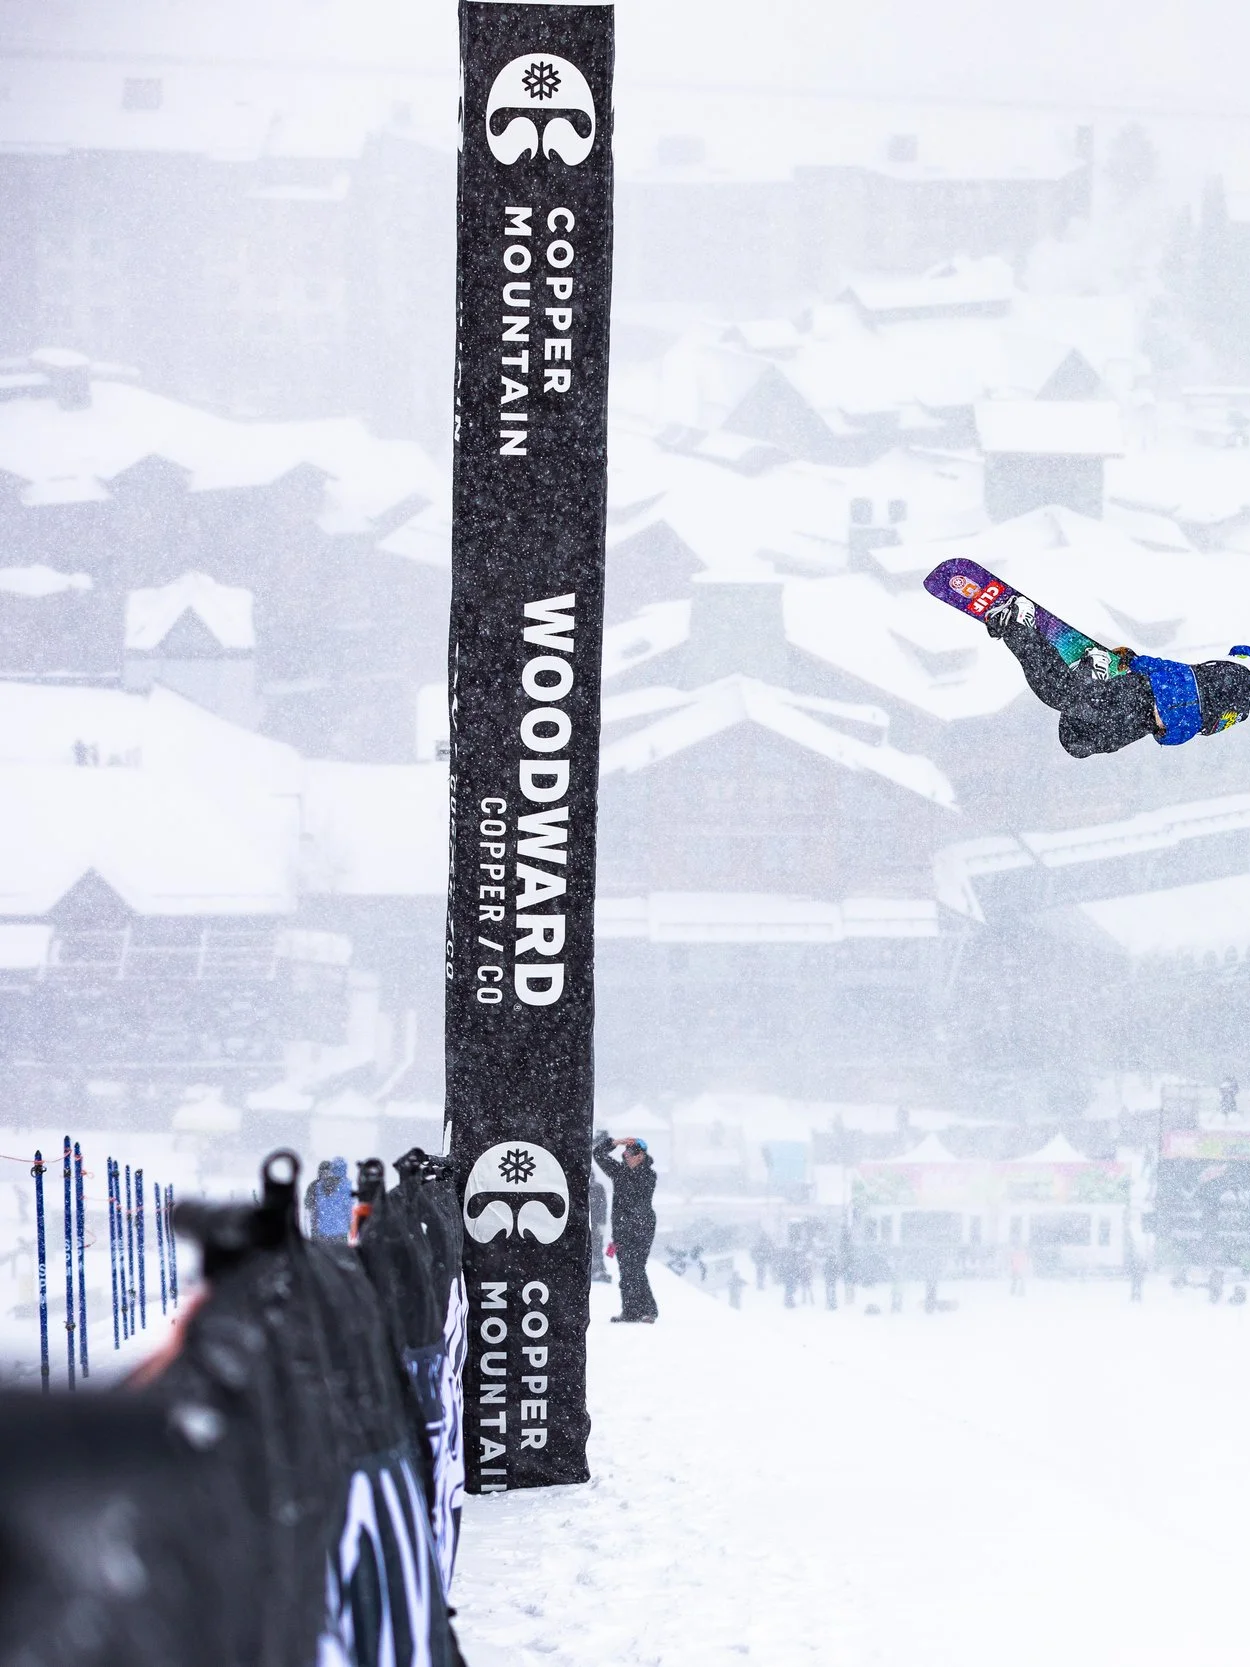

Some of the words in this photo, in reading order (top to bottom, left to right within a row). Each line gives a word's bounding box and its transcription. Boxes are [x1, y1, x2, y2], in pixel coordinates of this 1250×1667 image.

[500, 207, 532, 455] MOUNTAIN
[543, 207, 575, 393] COPPER
[973, 586, 999, 612] CLIF
[479, 797, 506, 921] COPPER
[514, 593, 575, 1006] WOODWARD
[477, 965, 504, 1004] CO
[520, 1280, 549, 1449] COPPER
